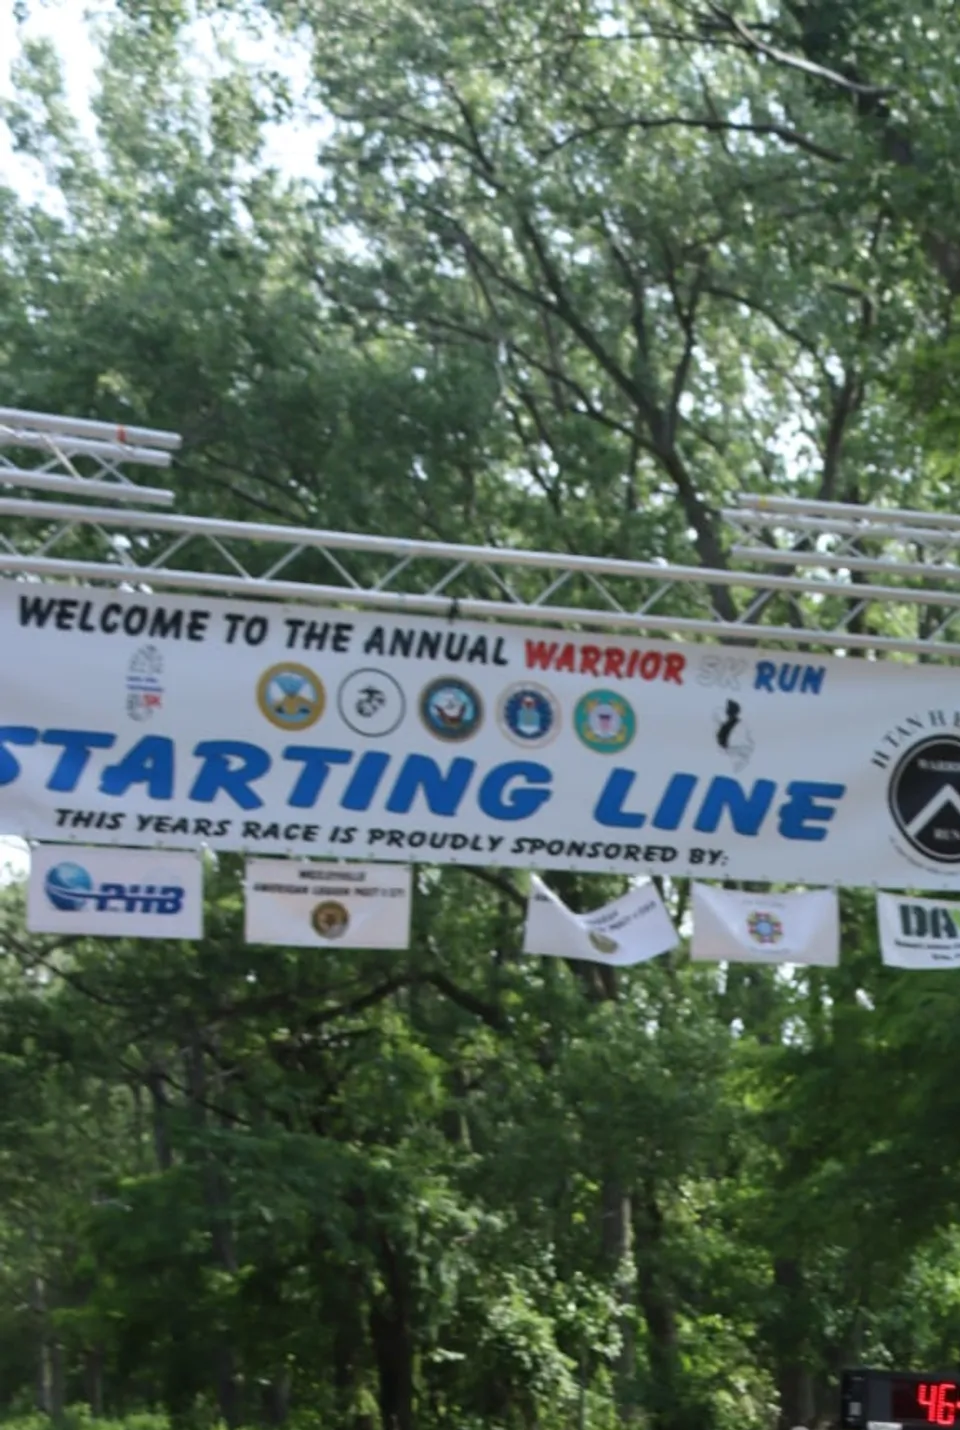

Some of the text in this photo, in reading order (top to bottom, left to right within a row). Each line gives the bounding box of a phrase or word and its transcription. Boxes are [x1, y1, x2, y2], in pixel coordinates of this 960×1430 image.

[18, 595, 826, 695] WELCOME TO THE ANNUAL WARRIOR 5K RUN
[54, 808, 729, 867] THIS YEARS RACE IS PROUDLY SPONSORED BY:
[593, 766, 846, 842] LINE
